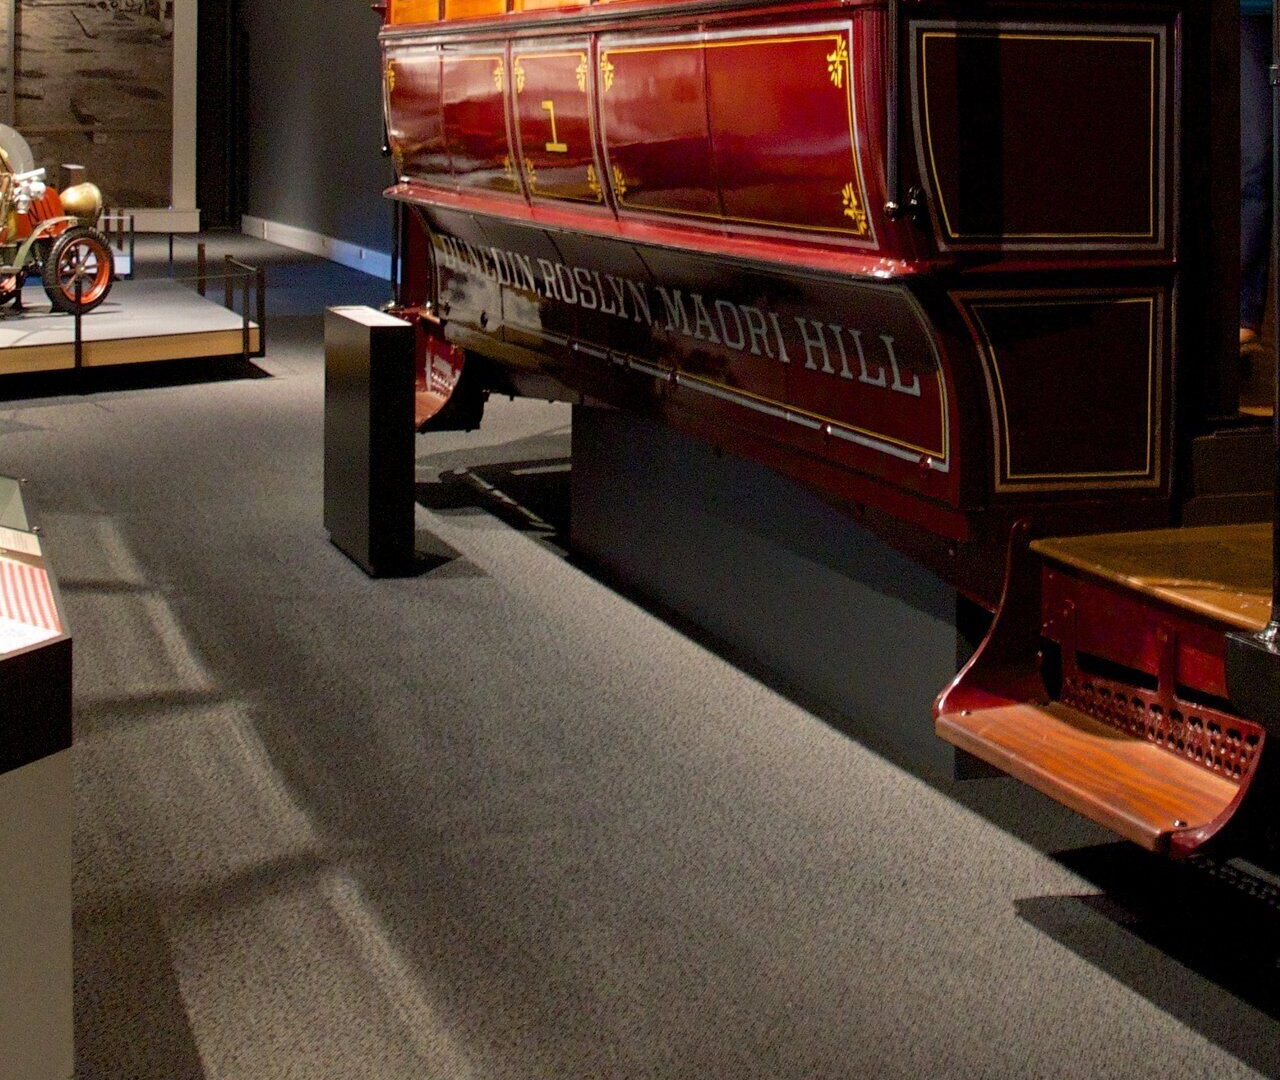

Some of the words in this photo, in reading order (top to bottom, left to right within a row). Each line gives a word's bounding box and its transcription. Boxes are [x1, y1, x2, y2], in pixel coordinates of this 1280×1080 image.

[541, 101, 568, 152] 1
[655, 285, 791, 364] MAORI
[794, 316, 922, 398] HILL
